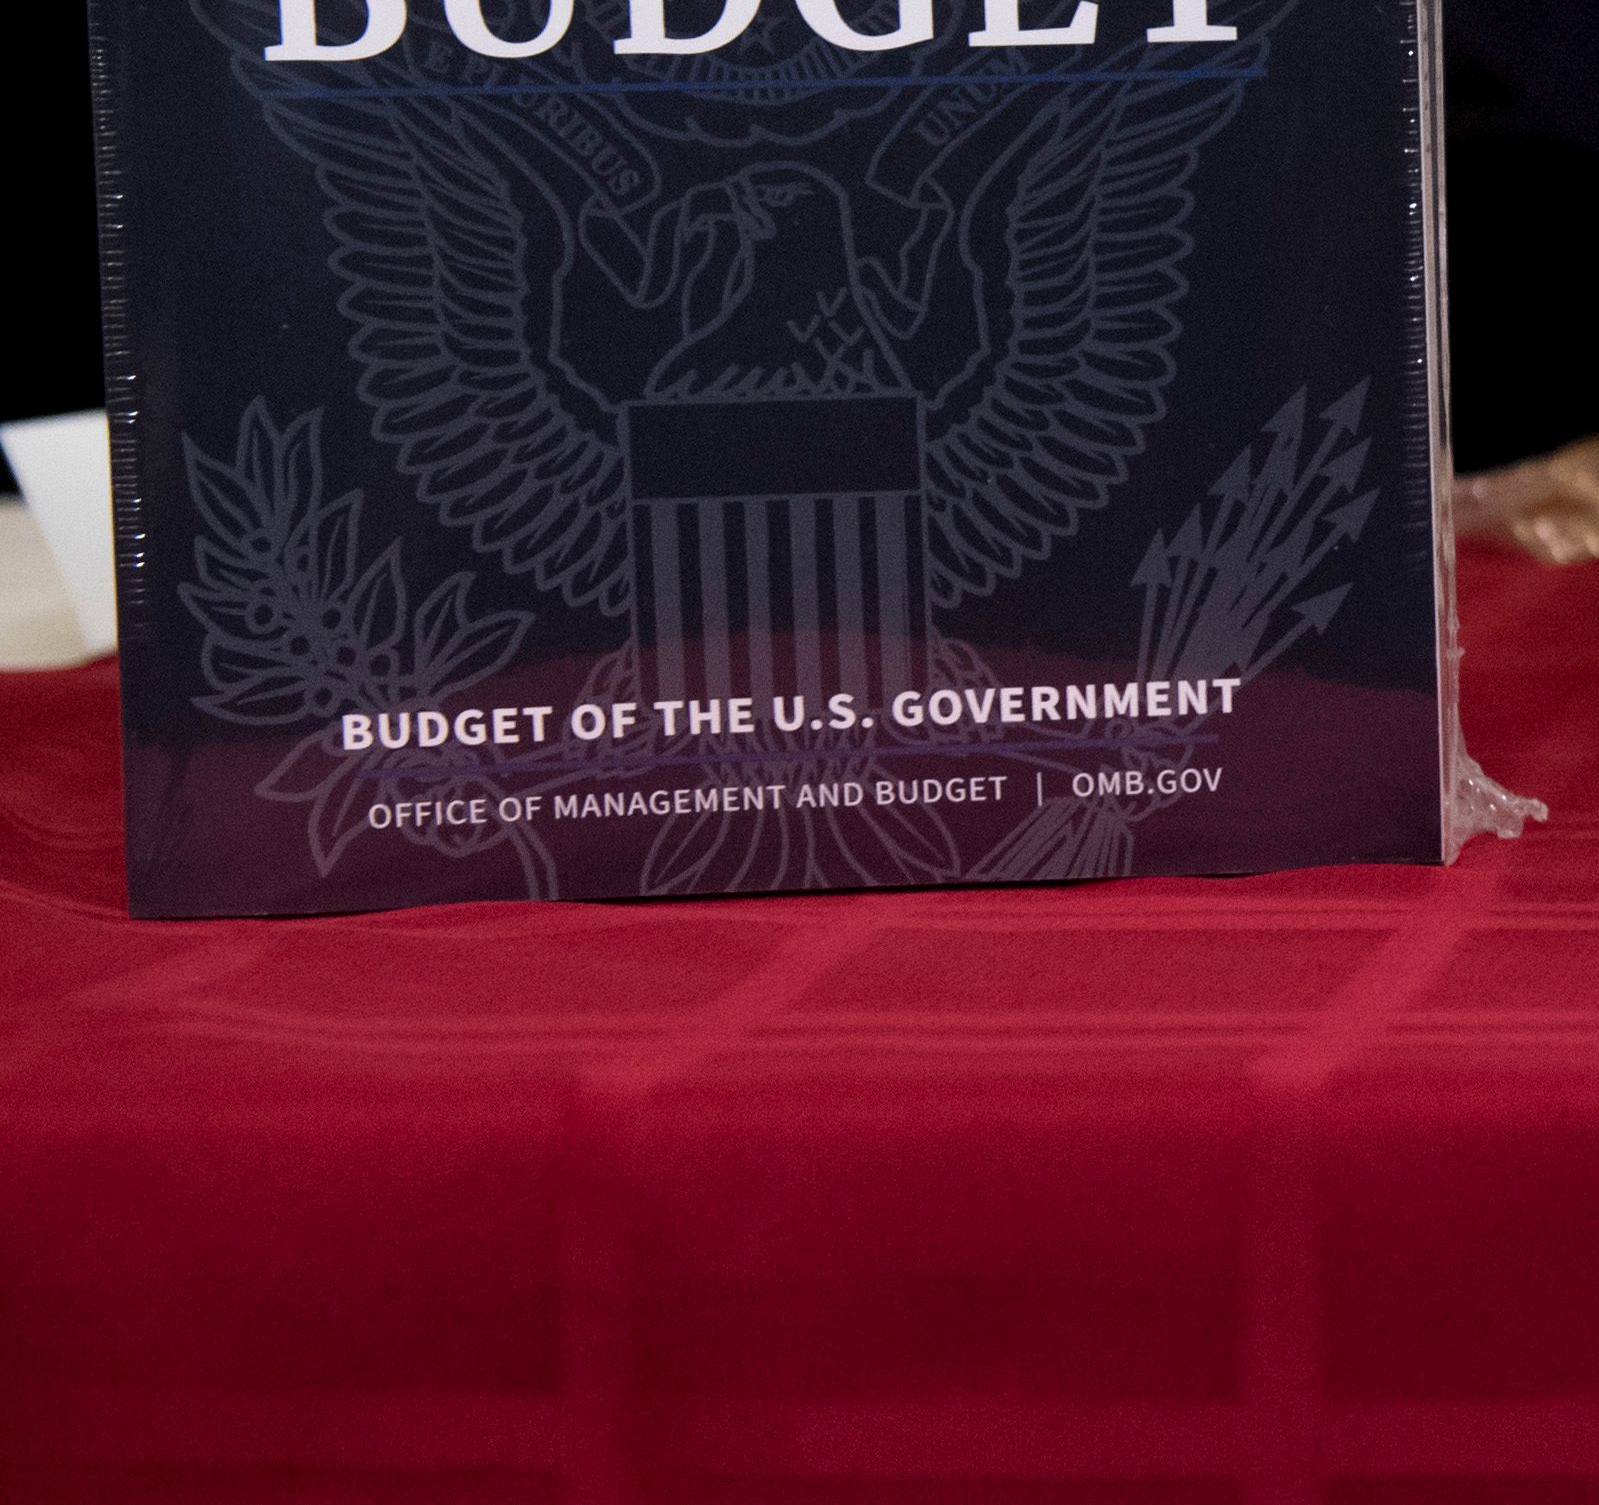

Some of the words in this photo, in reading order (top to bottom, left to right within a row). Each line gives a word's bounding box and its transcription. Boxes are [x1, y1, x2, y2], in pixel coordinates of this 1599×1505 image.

[343, 707, 552, 750] BUDGET
[571, 703, 636, 740] OF
[654, 698, 754, 736] THE
[773, 694, 873, 731] U.S.
[892, 678, 1241, 727] GOVERNMENT
[368, 799, 486, 828] OFFICE
[499, 796, 541, 822] OF
[554, 785, 786, 819] MANAGEMENT
[796, 782, 863, 808] AND
[876, 776, 1007, 805] BUDGET
[1072, 768, 1222, 797] OMB.GOV
